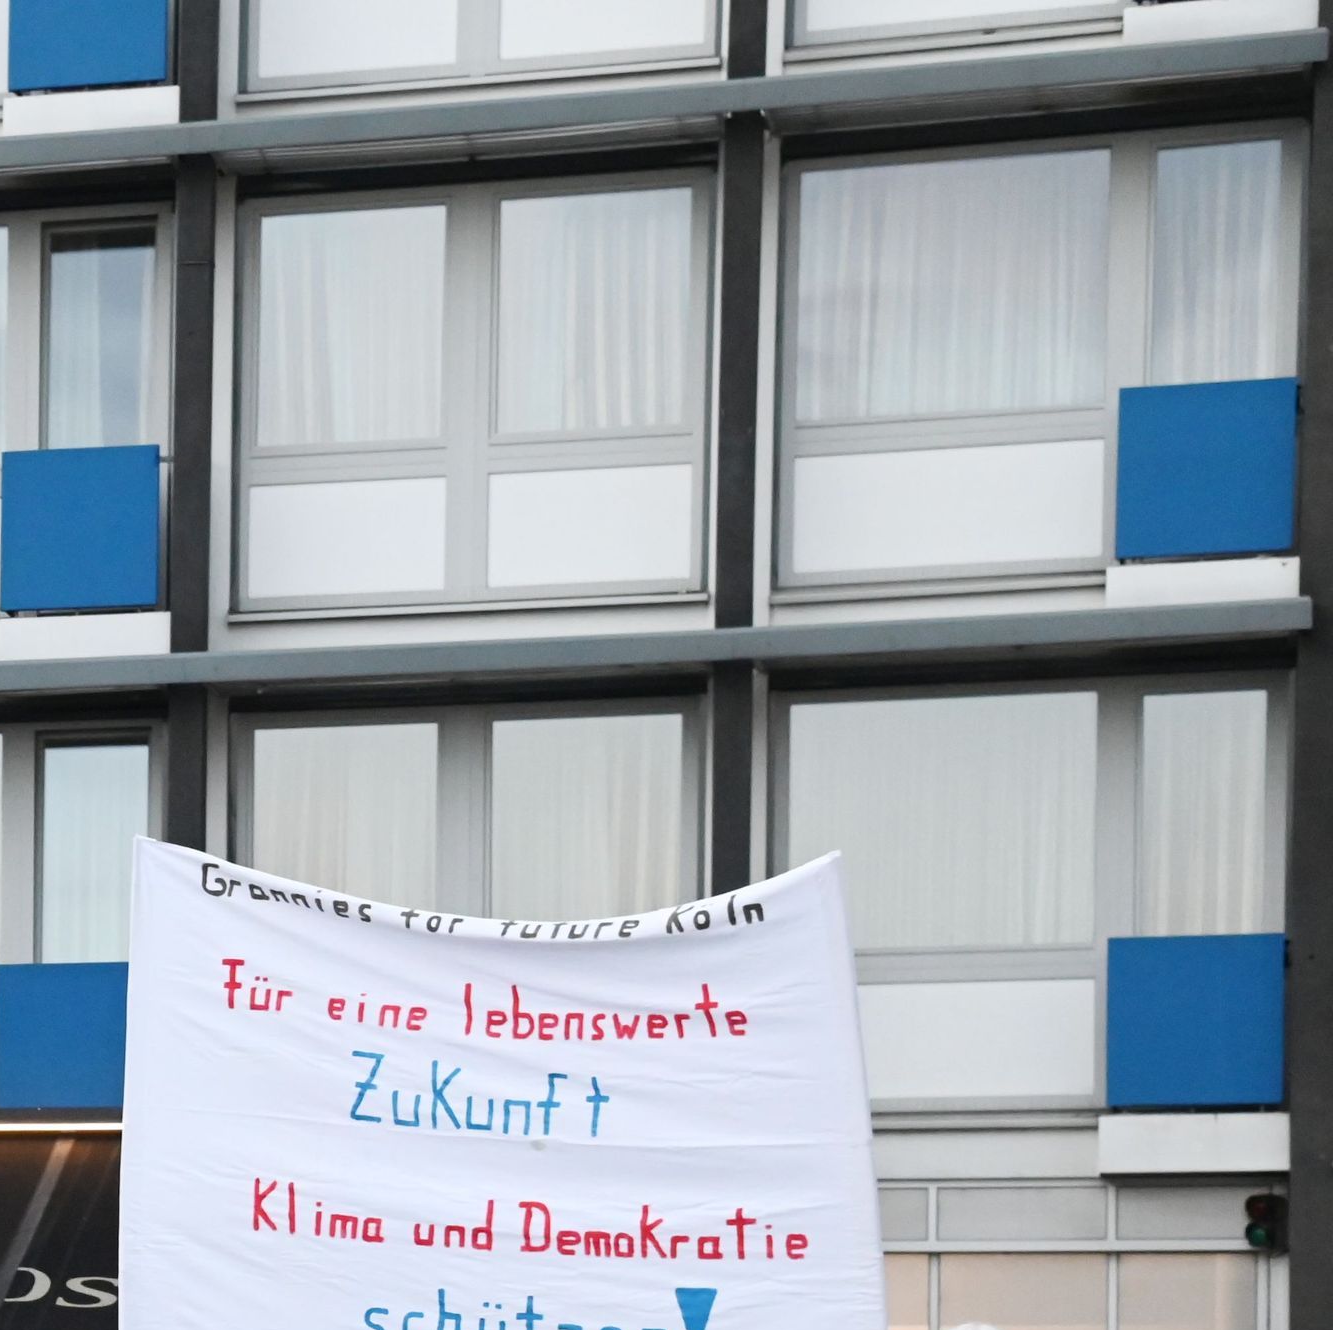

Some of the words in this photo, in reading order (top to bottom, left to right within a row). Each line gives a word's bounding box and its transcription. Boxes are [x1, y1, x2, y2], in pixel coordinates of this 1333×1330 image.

[201, 862, 372, 923] Grannies
[665, 894, 765, 935] Köln
[221, 958, 294, 1012] Für
[327, 993, 428, 1032] eine
[464, 983, 748, 1041] lebenswerte
[253, 1177, 385, 1243] Klima
[413, 1199, 495, 1251] und
